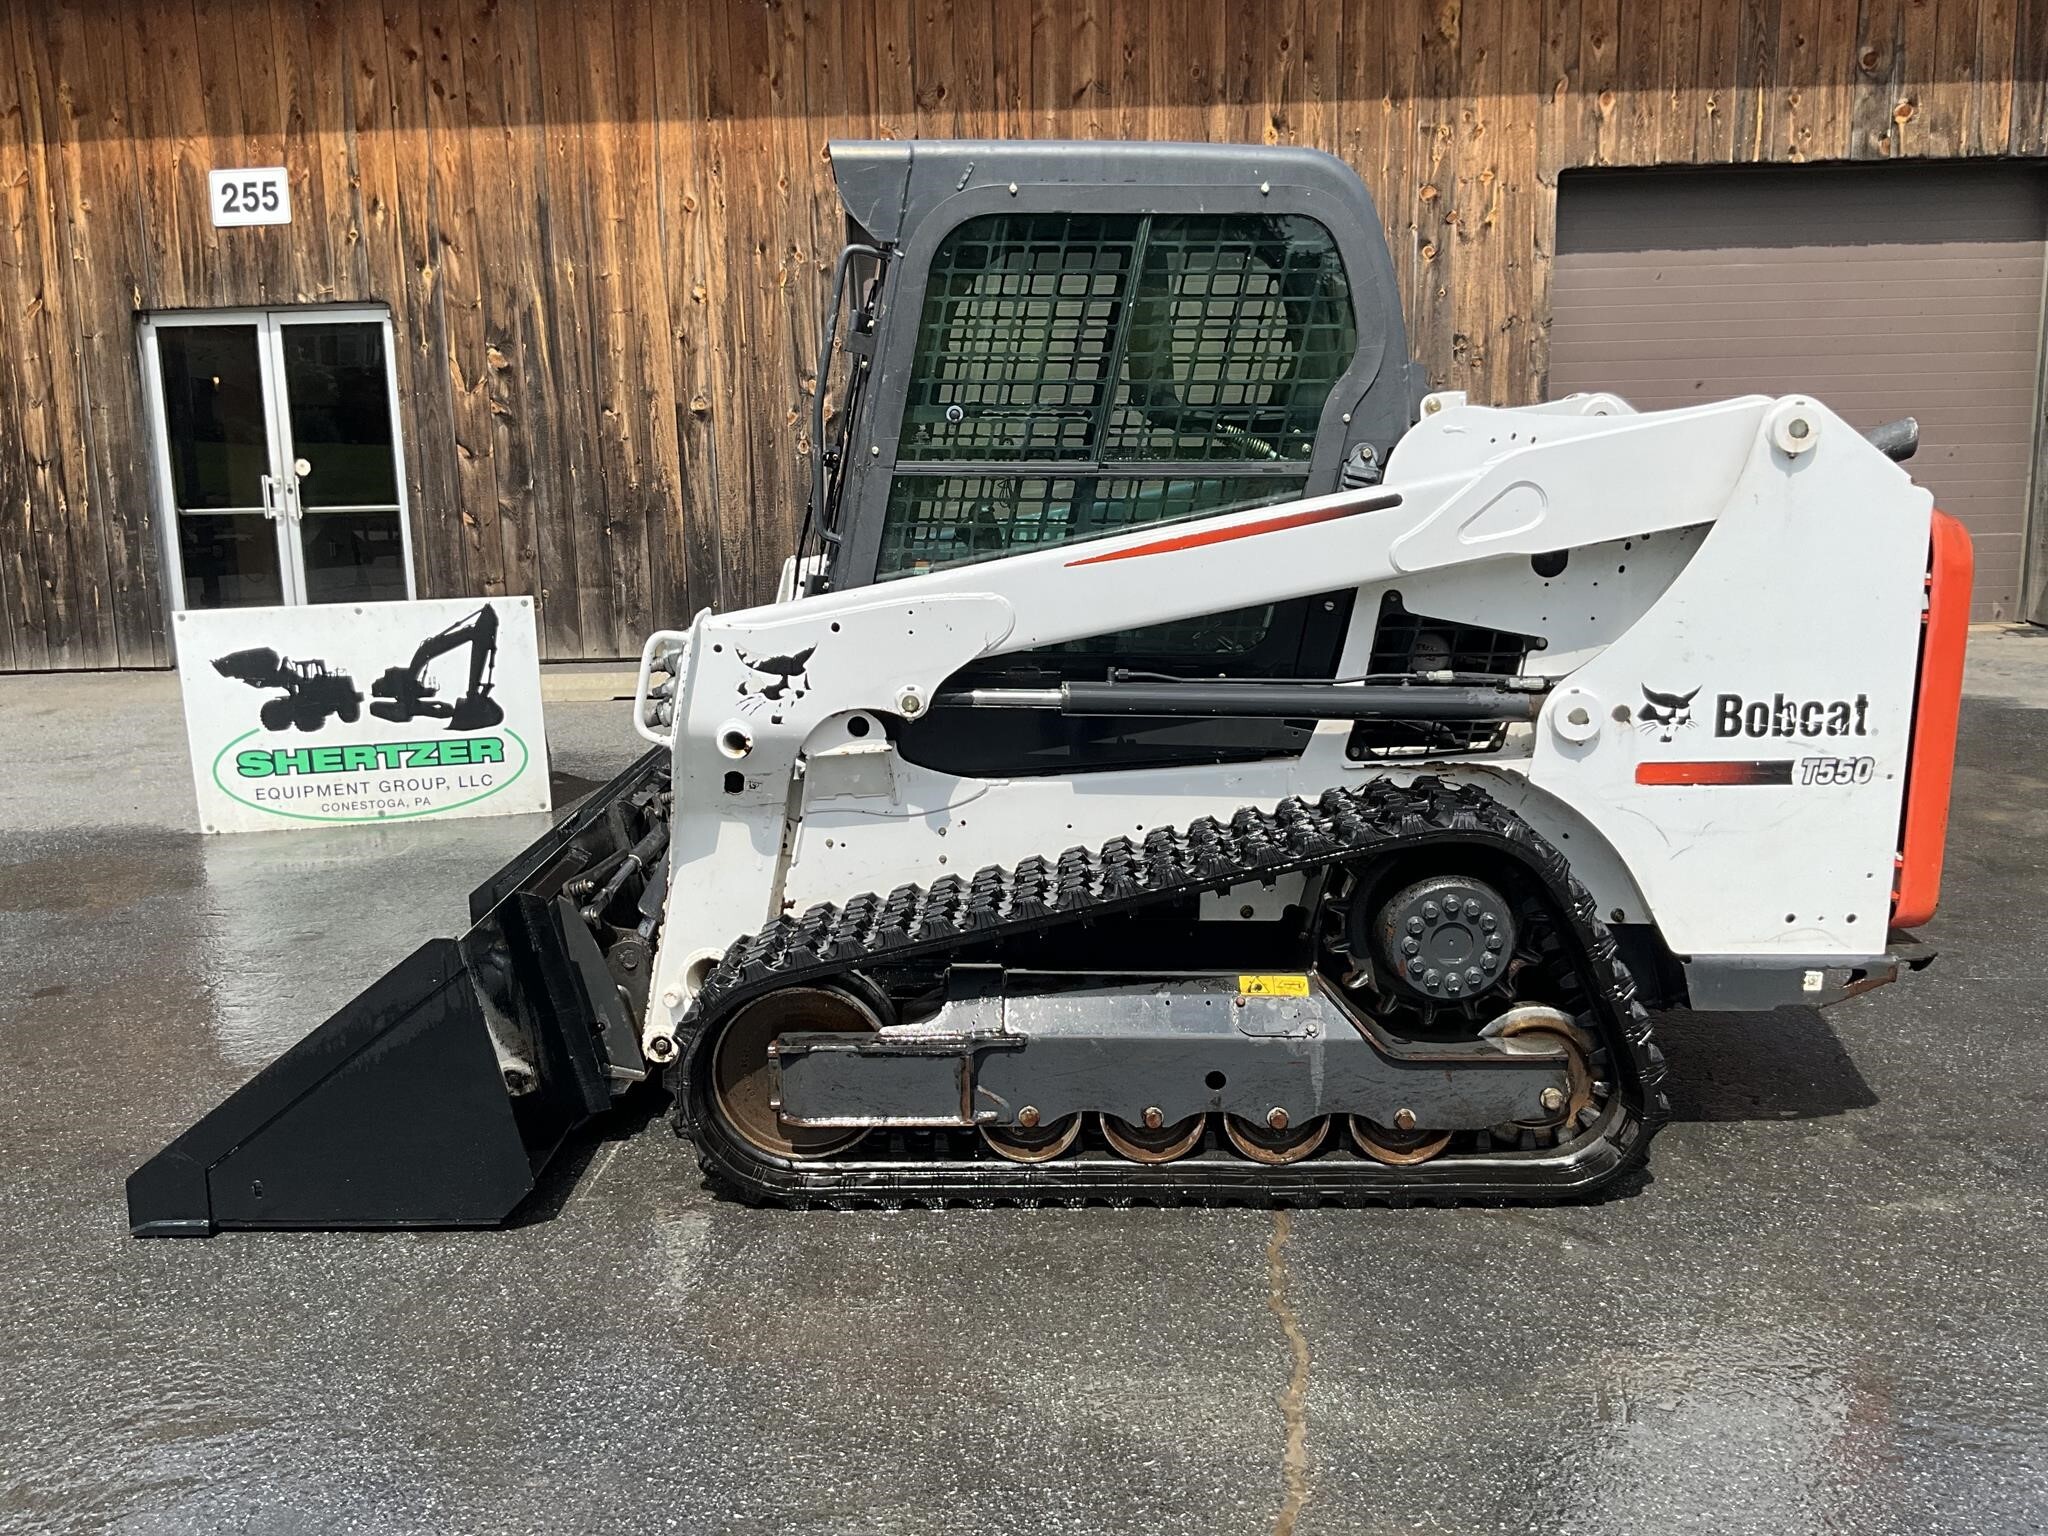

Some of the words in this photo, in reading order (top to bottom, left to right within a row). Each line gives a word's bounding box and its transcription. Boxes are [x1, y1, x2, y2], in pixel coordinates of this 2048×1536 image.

[221, 180, 279, 213] 255
[1714, 693, 1869, 738] Bobcat
[236, 737, 504, 777] SHERTZER
[1801, 756, 1875, 785] T550
[255, 782, 370, 801] EQUIPMENT
[379, 777, 450, 794] GROUP,
[459, 774, 493, 788] LLC
[321, 800, 409, 812] CONESTOGA,
[415, 797, 432, 807] PA
